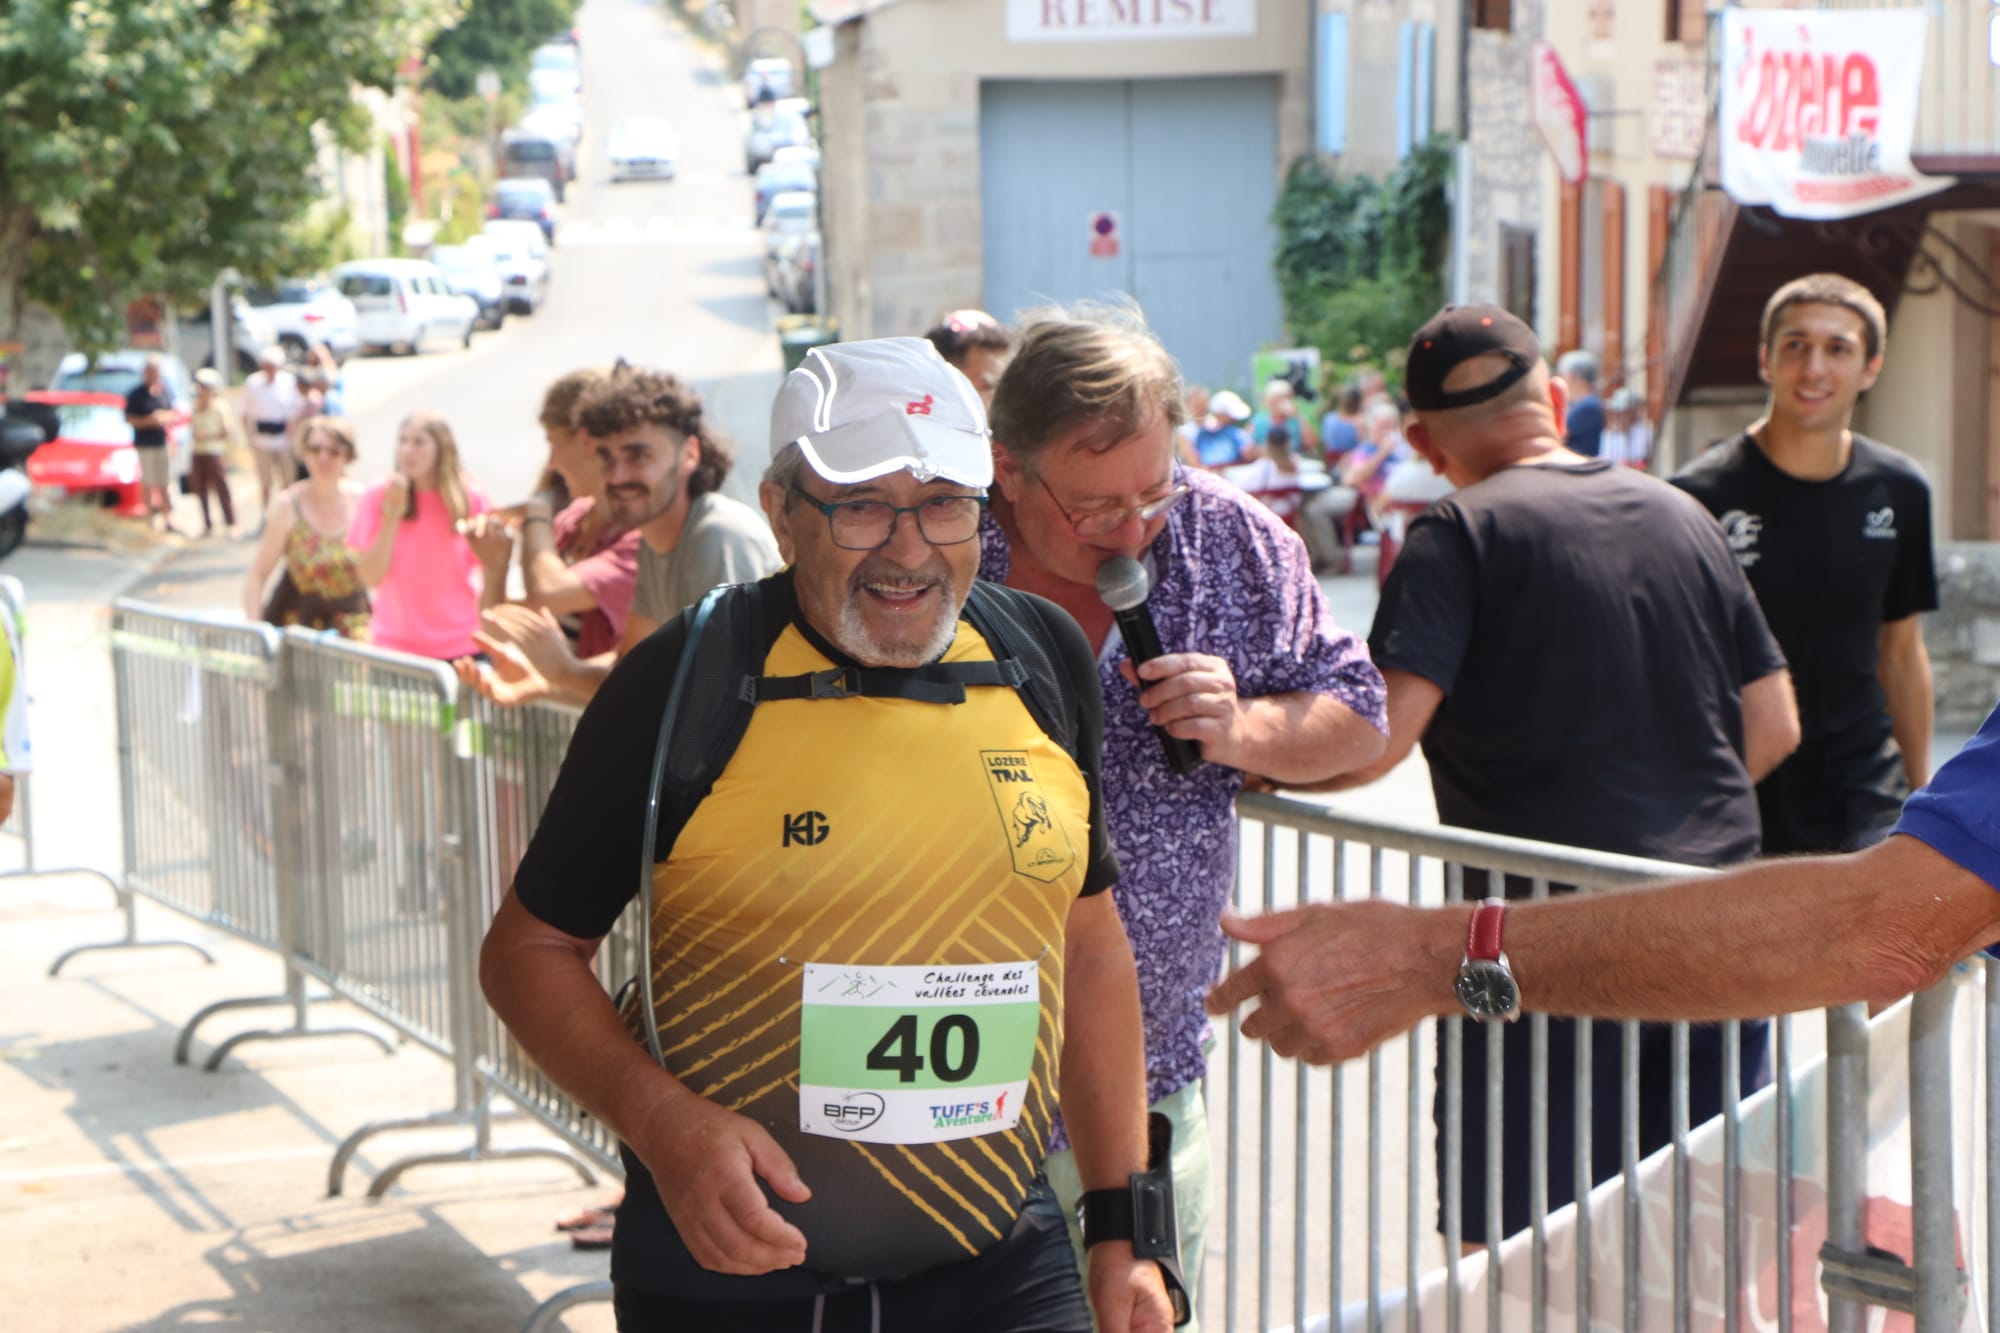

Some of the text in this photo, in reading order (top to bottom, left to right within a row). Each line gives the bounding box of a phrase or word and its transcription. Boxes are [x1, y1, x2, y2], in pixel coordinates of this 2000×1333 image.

[1040, 0, 1225, 26] REMISE
[991, 769, 1034, 783] TRAIL
[924, 970, 1023, 987] Challenge des
[915, 985, 966, 998] vallées
[866, 1013, 980, 1083] 40
[823, 1103, 876, 1120] BFP
[929, 1101, 990, 1119] TUFF'S
[934, 1113, 993, 1129] Aventure
